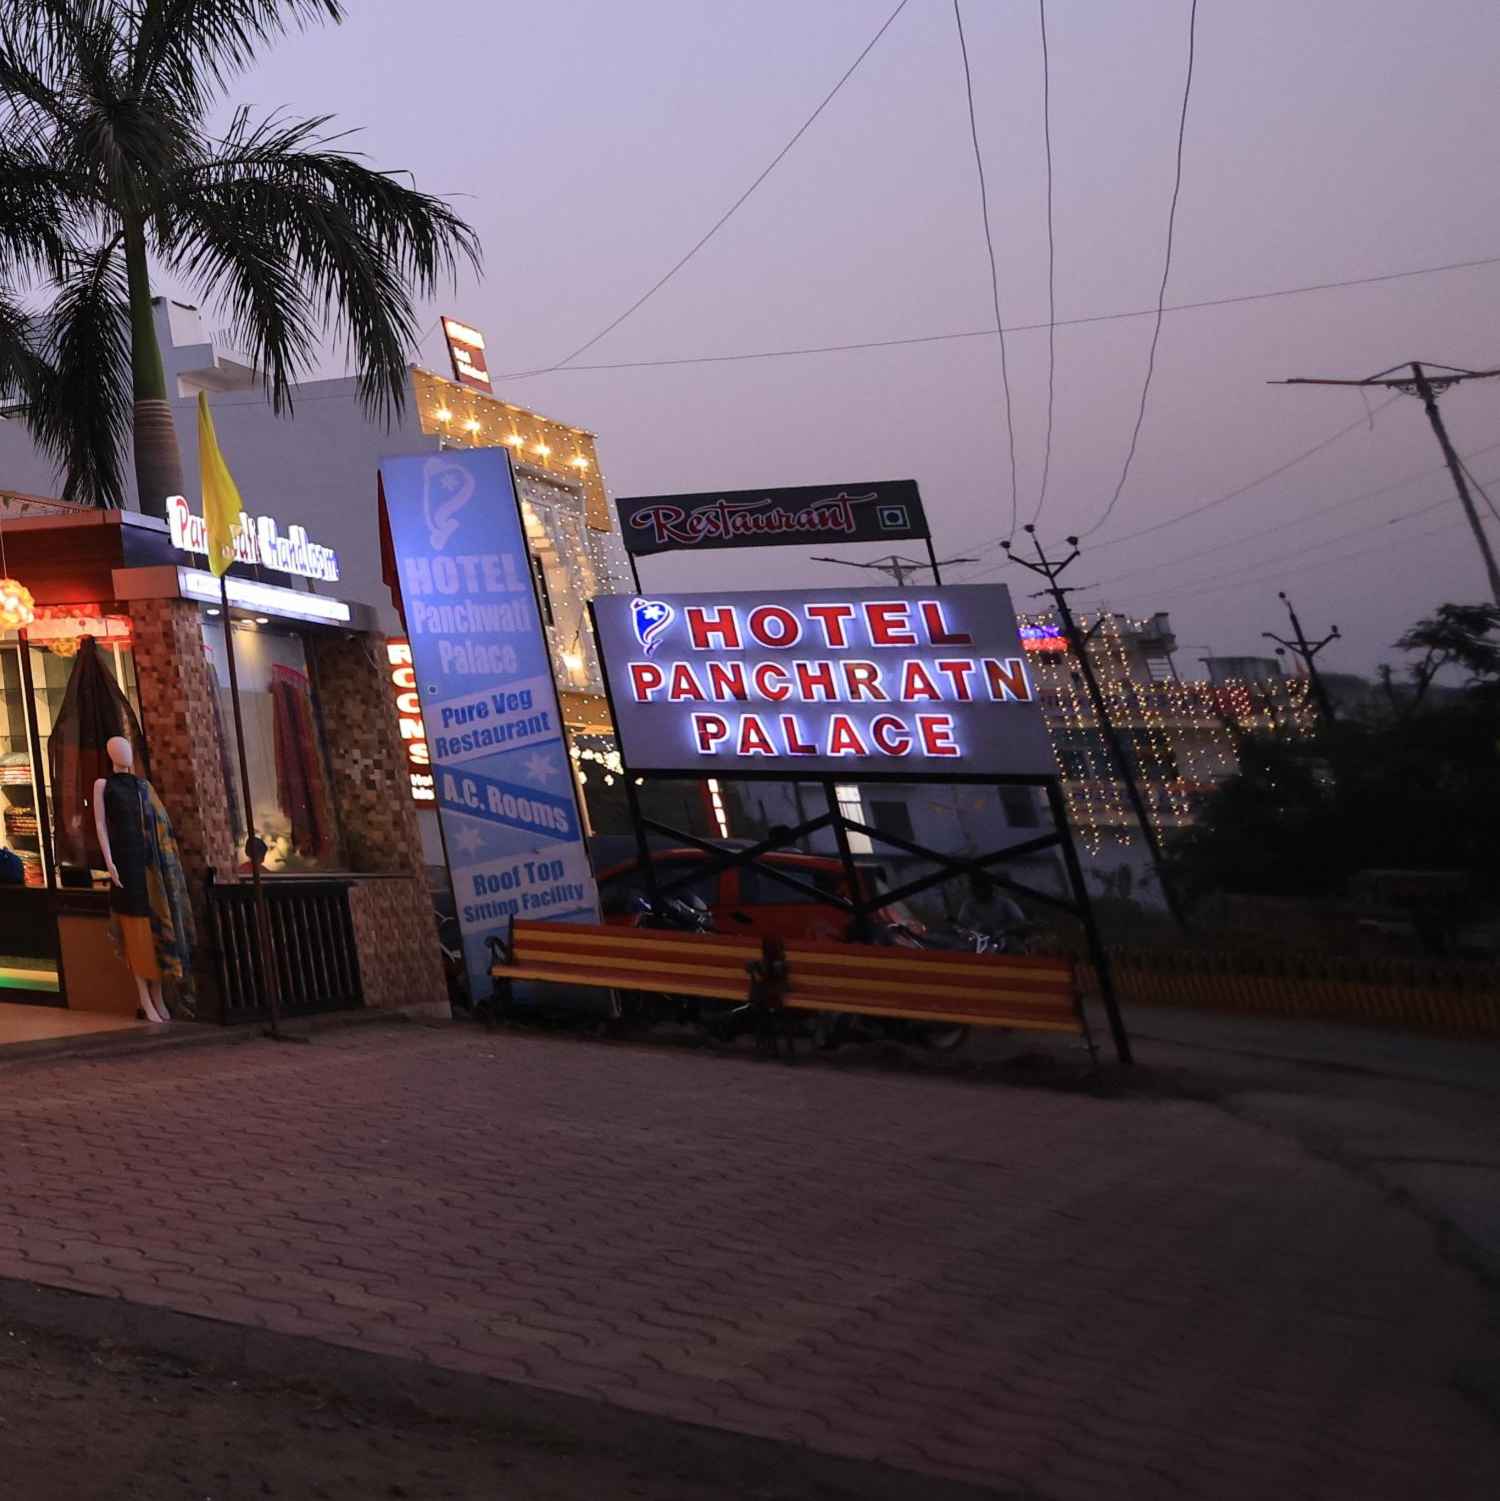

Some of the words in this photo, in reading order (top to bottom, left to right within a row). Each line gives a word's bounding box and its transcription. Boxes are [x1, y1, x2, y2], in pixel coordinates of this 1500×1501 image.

[630, 492, 877, 543] Restaurant
[404, 553, 526, 595] HOTEL
[412, 598, 533, 634] Panchwati
[685, 600, 974, 650] HOTEL
[438, 640, 518, 674] Palace
[628, 658, 1033, 703] PANCHRATN
[441, 701, 489, 728] Pure
[491, 689, 533, 714] Veg
[435, 712, 551, 758] Restaurant
[692, 713, 961, 758] PALACE
[443, 774, 485, 809] A.C.
[472, 865, 521, 896] Roof
[524, 860, 565, 884] Top
[463, 898, 519, 924] Sitting
[521, 884, 584, 910] Facility
